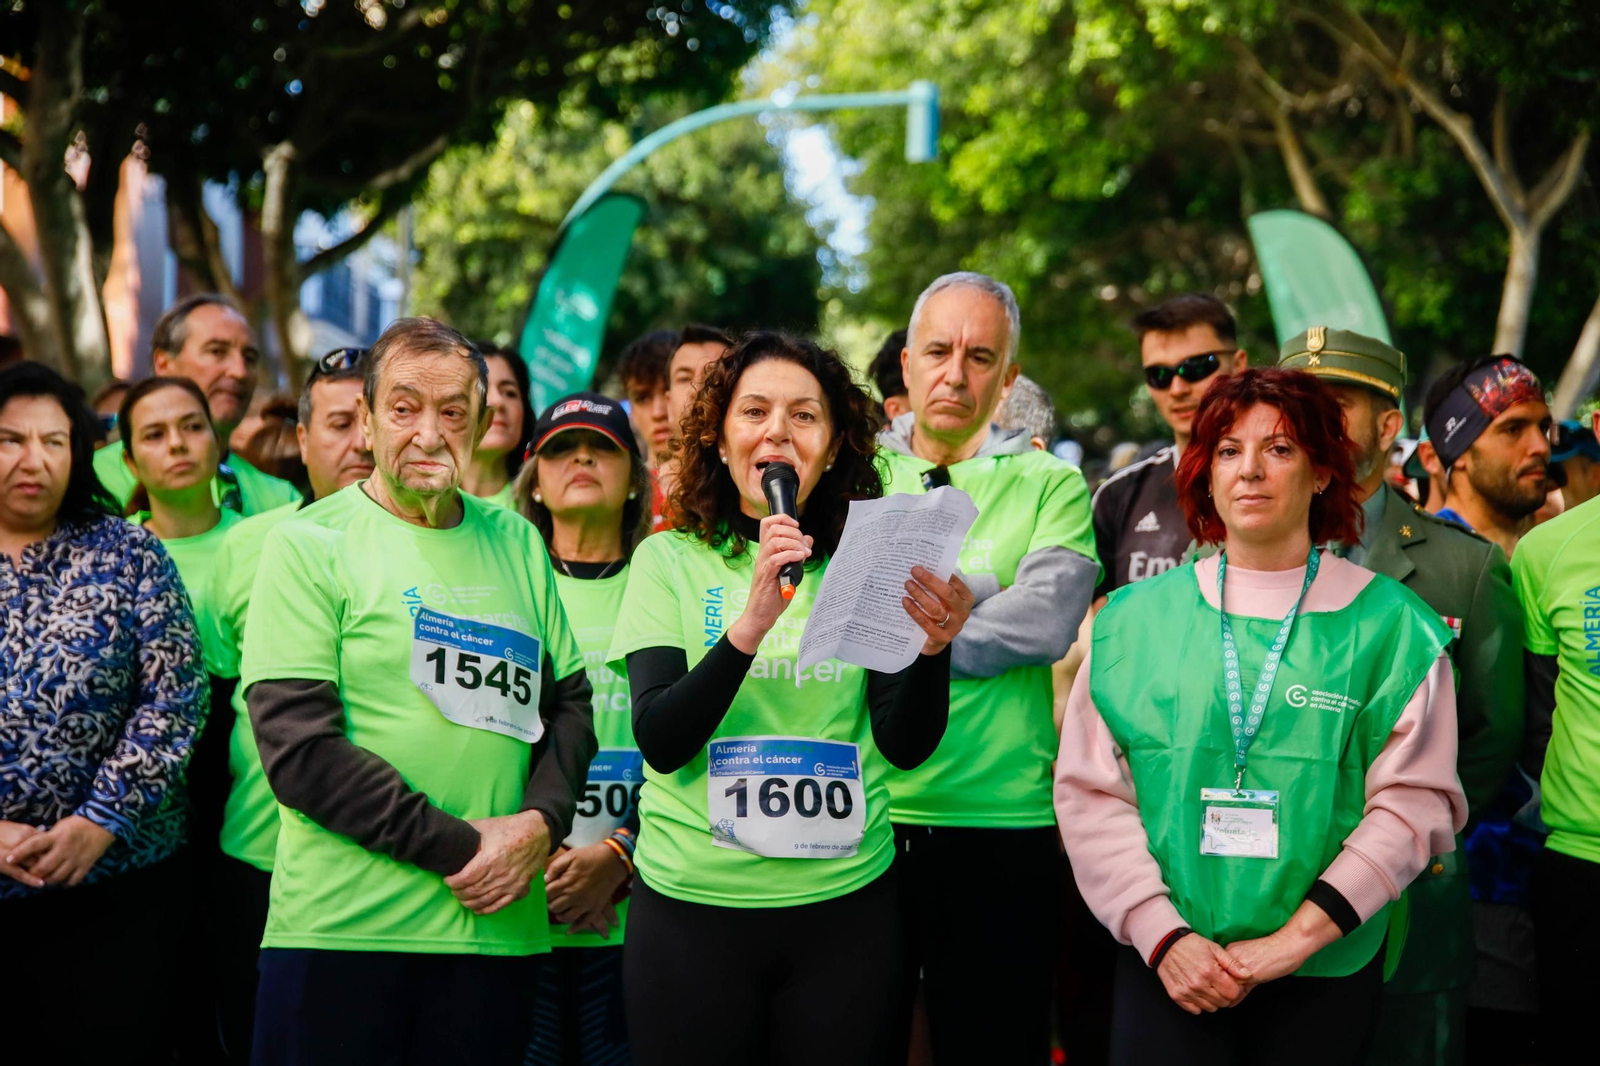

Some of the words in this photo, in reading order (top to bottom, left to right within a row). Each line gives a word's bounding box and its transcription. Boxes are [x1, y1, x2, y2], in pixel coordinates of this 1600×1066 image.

[420, 612, 454, 628] Almería
[420, 622, 449, 638] contra
[451, 631, 459, 640] el
[461, 633, 493, 646] cáncer
[426, 647, 531, 706] 1545
[593, 693, 632, 713] nc
[1310, 696, 1331, 704] contra
[1318, 704, 1342, 713] Almería
[716, 745, 757, 754] Almería
[716, 756, 750, 766] contra
[753, 754, 764, 764] el
[766, 754, 803, 764] cáncer
[725, 777, 853, 820] 1600
